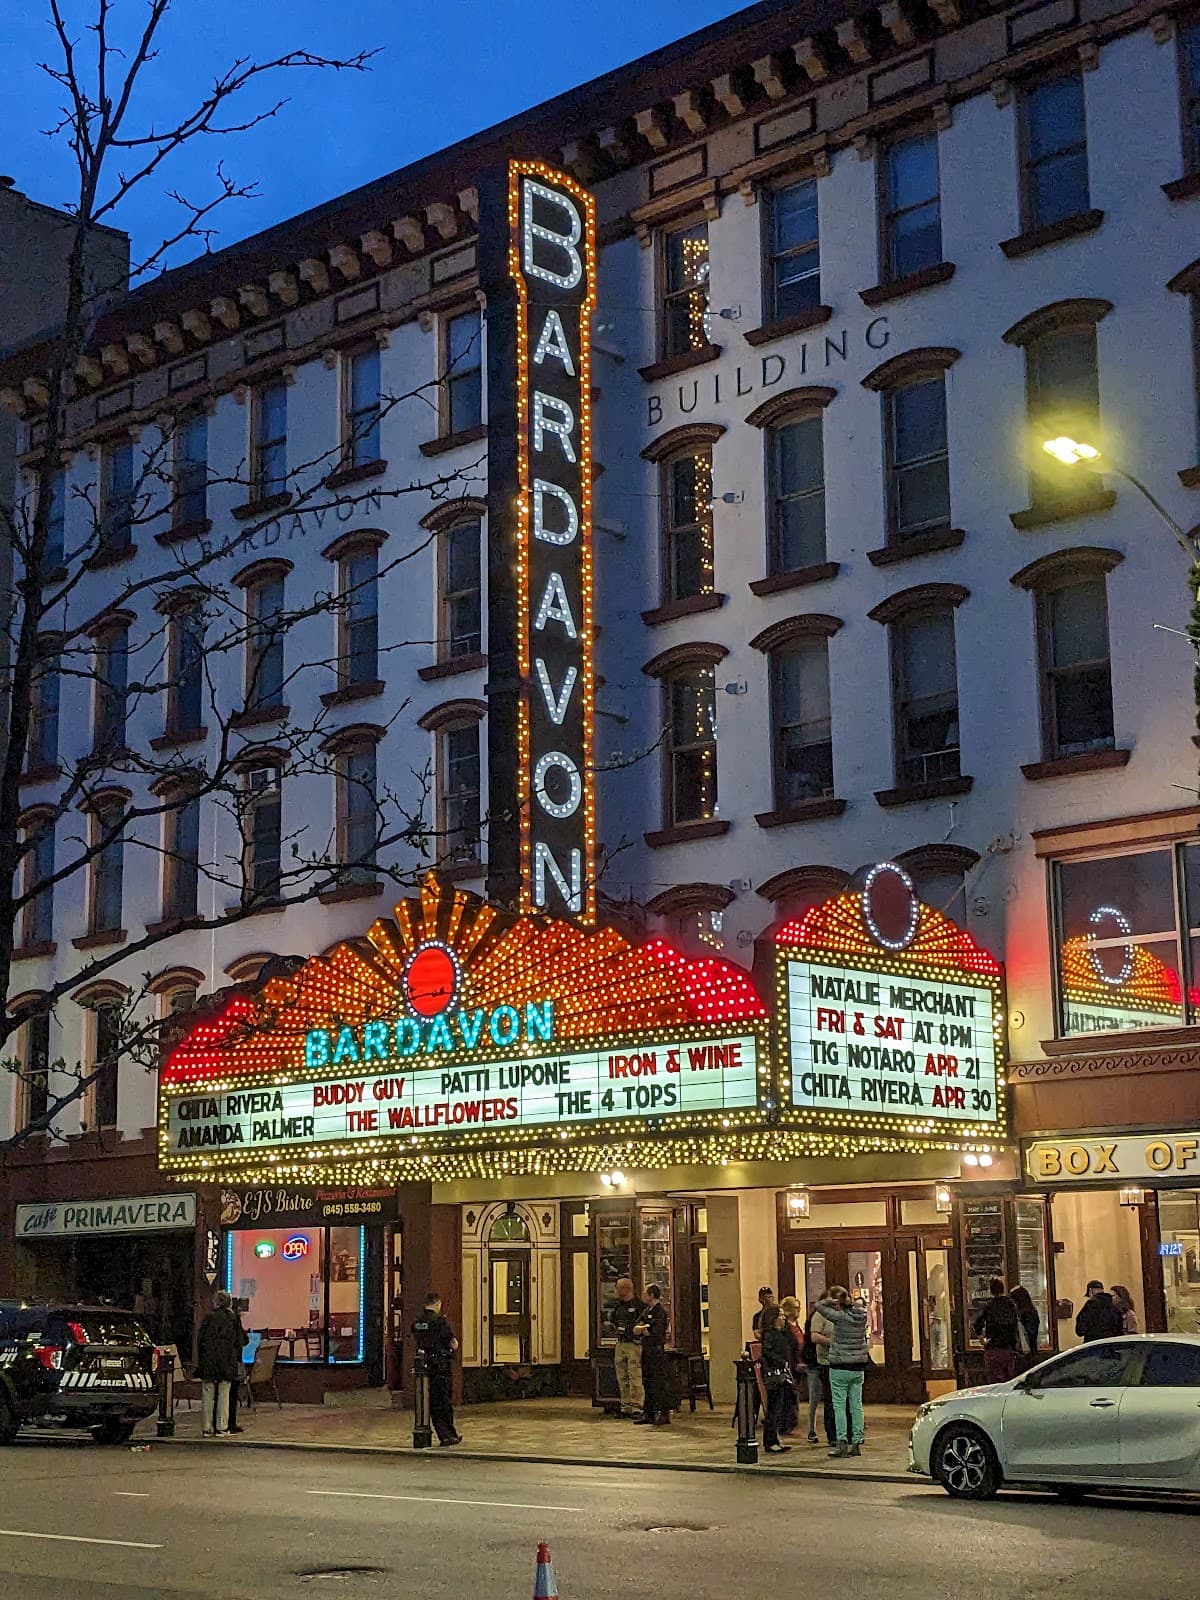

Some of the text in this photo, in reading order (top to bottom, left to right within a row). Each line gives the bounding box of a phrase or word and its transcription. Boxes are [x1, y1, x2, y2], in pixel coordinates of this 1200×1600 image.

[647, 316, 892, 427] BUILDING
[523, 178, 583, 912] BARDAVON
[811, 974, 977, 1018] NATALIE MERCHANT
[305, 999, 554, 1068] BARDAVON
[816, 1007, 846, 1034] FRI
[853, 1011, 866, 1036] &
[873, 1015, 905, 1041] SAT
[914, 1020, 934, 1045] AT
[608, 1043, 743, 1080] IRON & WINE
[810, 1039, 980, 1080] TIG NOTARO APR 21
[313, 1078, 406, 1107] BUDDY GUY
[441, 1061, 571, 1095] PATTI LUPONE
[801, 1073, 992, 1112] CHITA RIVERA APR 30
[177, 1090, 284, 1120] CHITA RIVERA
[346, 1097, 519, 1133] THE WALLFLOWERS
[555, 1083, 677, 1116] THE 4 TOPS
[177, 1116, 315, 1148] AMANDA PALMER
[1038, 1139, 1198, 1177] BOX OF
[63, 1201, 188, 1229] PRIMAVERA
[275, 1188, 313, 1213] Bistro
[323, 1204, 344, 1217] (845)
[283, 1242, 308, 1256] OPEN
[94, 1379, 127, 1387] POLICE
